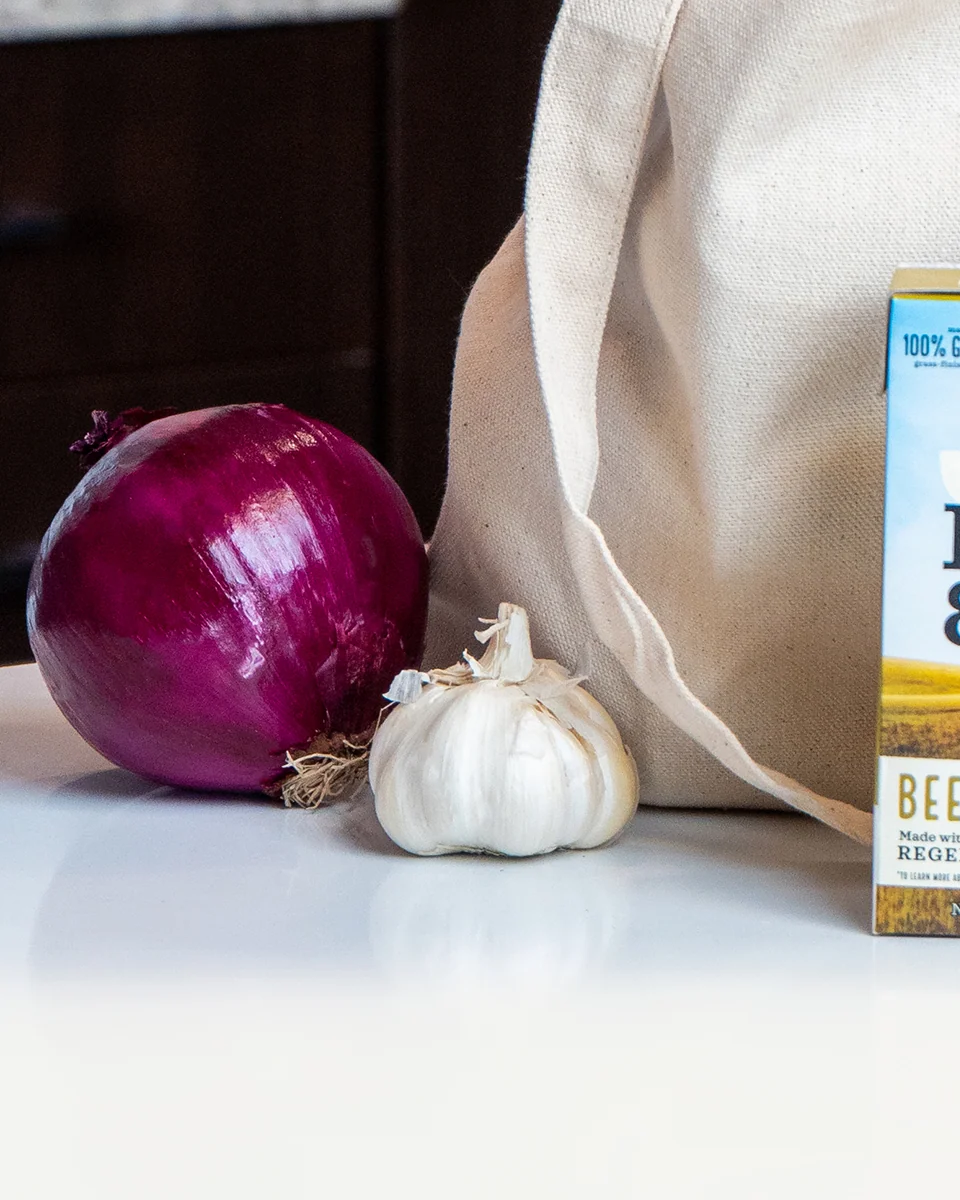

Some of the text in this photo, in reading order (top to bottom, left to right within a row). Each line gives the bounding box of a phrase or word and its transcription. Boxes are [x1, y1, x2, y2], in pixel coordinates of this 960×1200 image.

[903, 333, 946, 357] 100%
[898, 830, 937, 843] Made
[910, 872, 930, 881] LEARN
[933, 873, 950, 881] MORE
